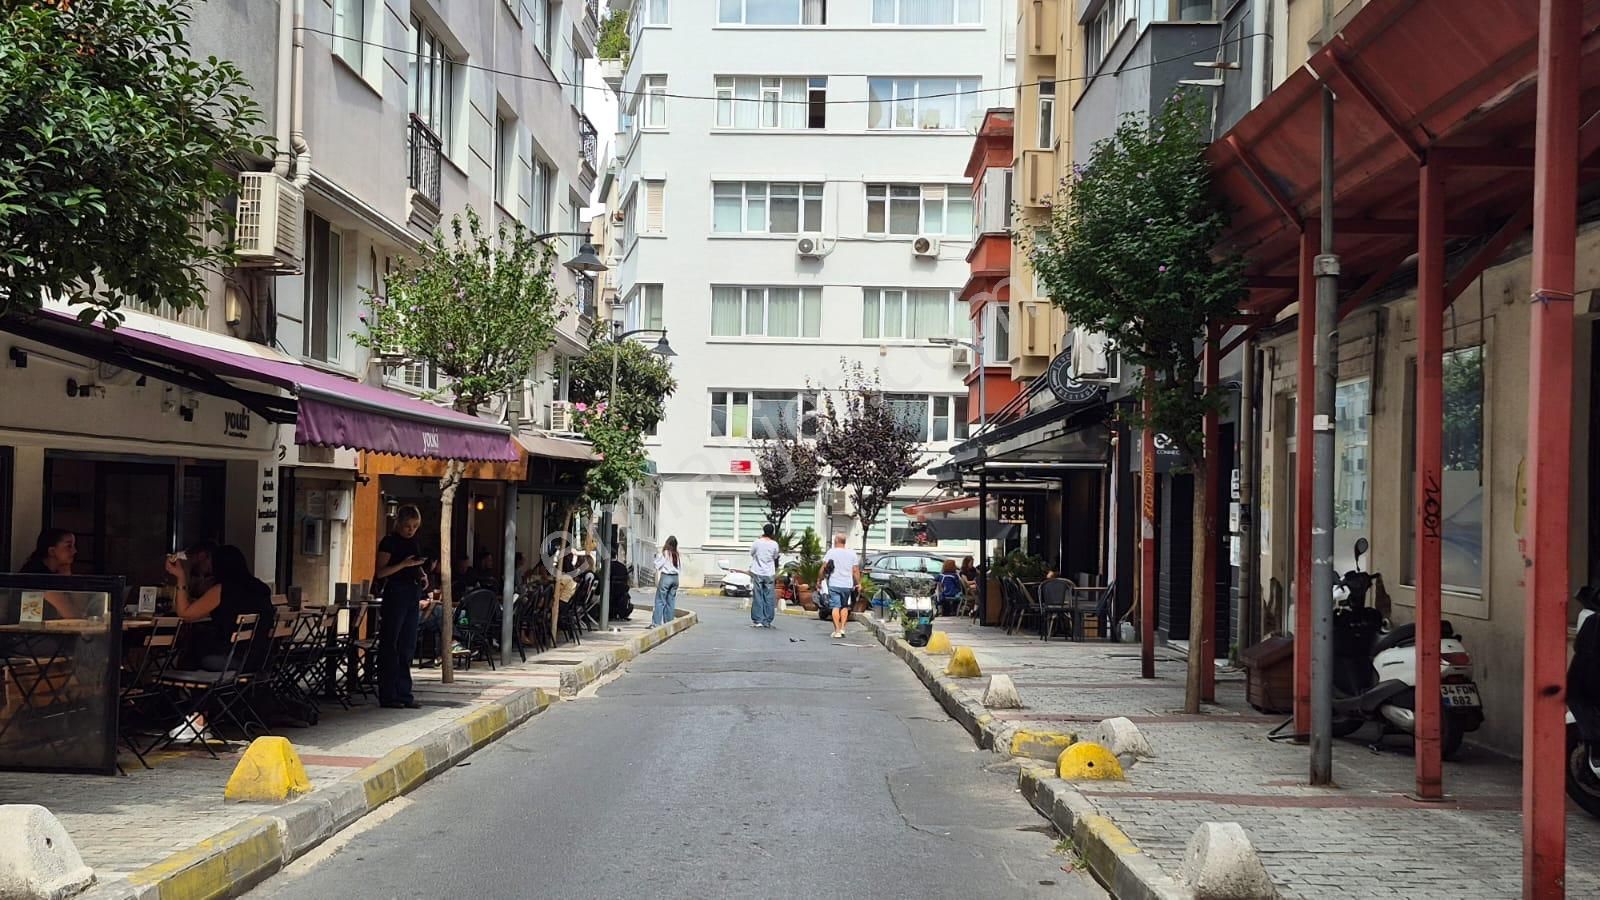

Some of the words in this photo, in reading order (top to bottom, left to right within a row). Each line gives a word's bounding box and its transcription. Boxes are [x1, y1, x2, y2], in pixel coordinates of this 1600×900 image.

[224, 407, 250, 435] youki
[422, 427, 439, 453] youki
[1441, 686, 1455, 695] 34
